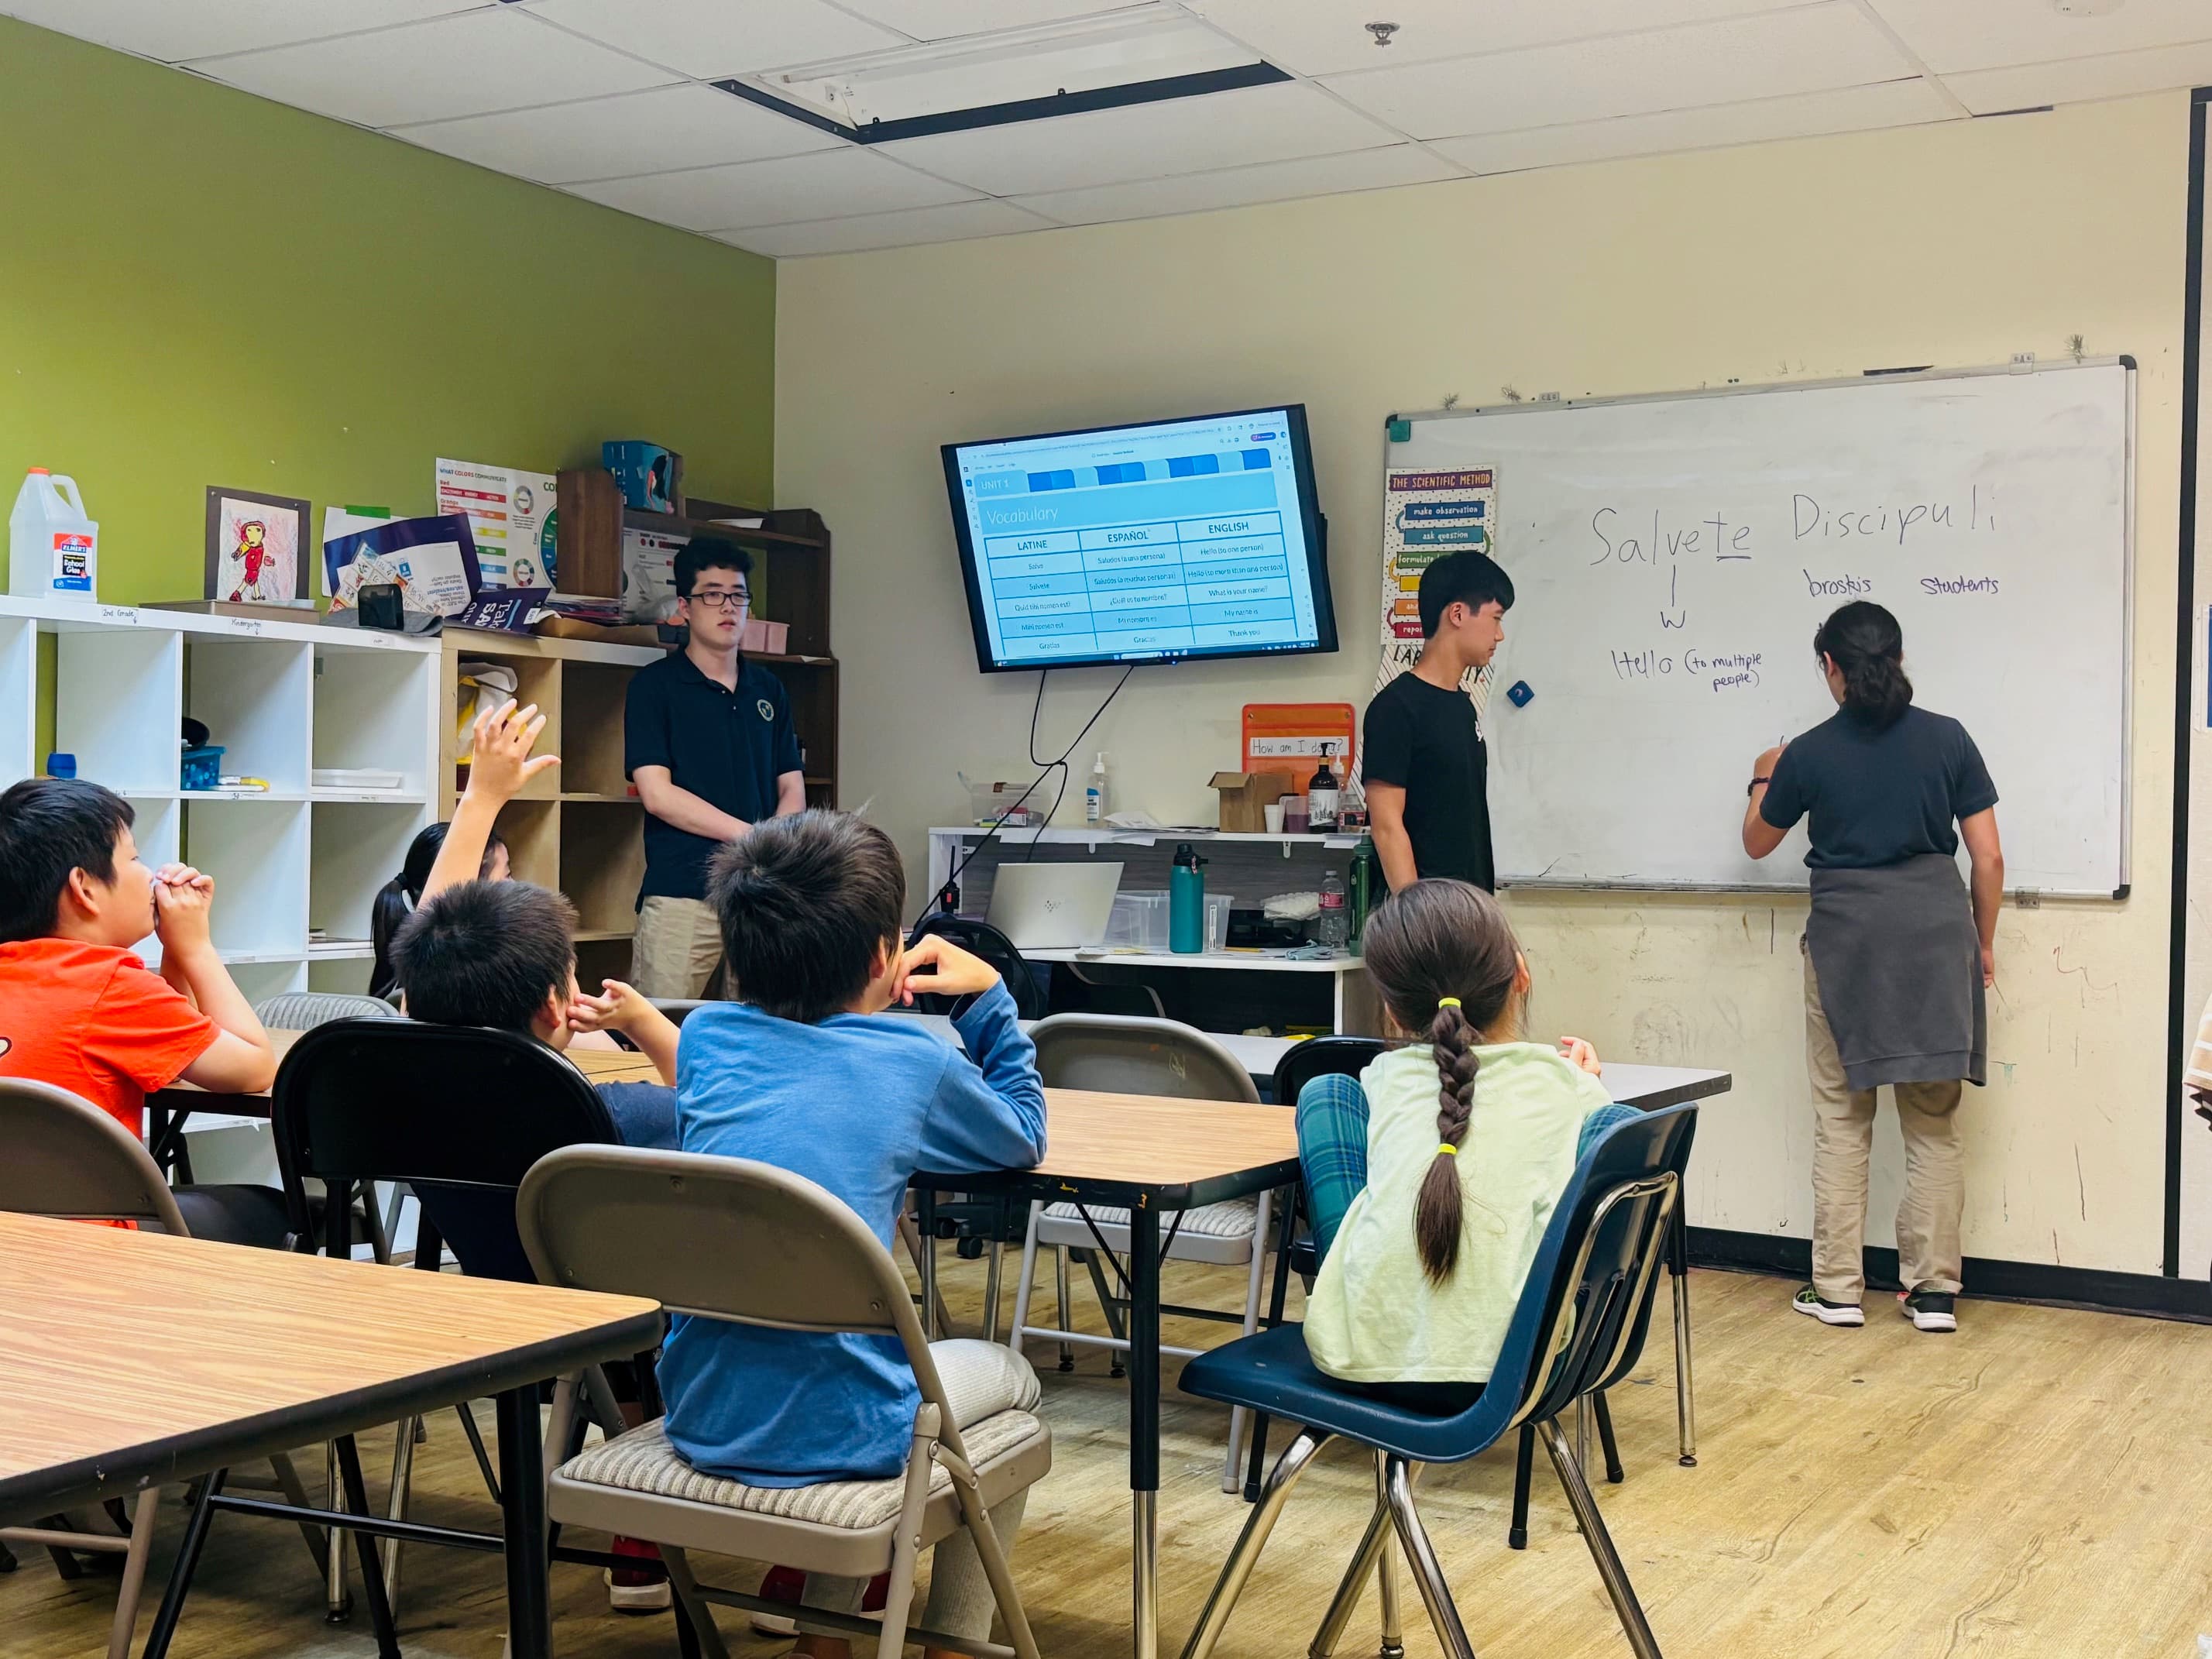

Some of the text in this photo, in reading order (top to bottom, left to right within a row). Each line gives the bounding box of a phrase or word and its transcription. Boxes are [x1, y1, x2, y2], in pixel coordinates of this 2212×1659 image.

[455, 469, 475, 478] COLORS
[981, 480, 1001, 489] UNIT
[1393, 473, 1490, 489] THE SCIENTIFIC METHOD
[986, 506, 1059, 525] Vocabulary
[1413, 504, 1479, 515] make observation
[1208, 521, 1249, 534] ENGLISH
[1589, 484, 1997, 566] Salvete Discipuli
[1108, 531, 1149, 543] ESPAÑOL
[1422, 531, 1468, 541] ask question
[1017, 540, 1048, 551] LATINE
[1398, 553, 1434, 563] formulate
[1802, 568, 1872, 597] broskis
[102, 609, 134, 617] 2nd Grade
[1611, 648, 1762, 680] Hello (to multiple
[1712, 669, 1760, 692] people)
[1252, 738, 1273, 754] How
[1279, 744, 1292, 753] am
[1297, 740, 1306, 753] I
